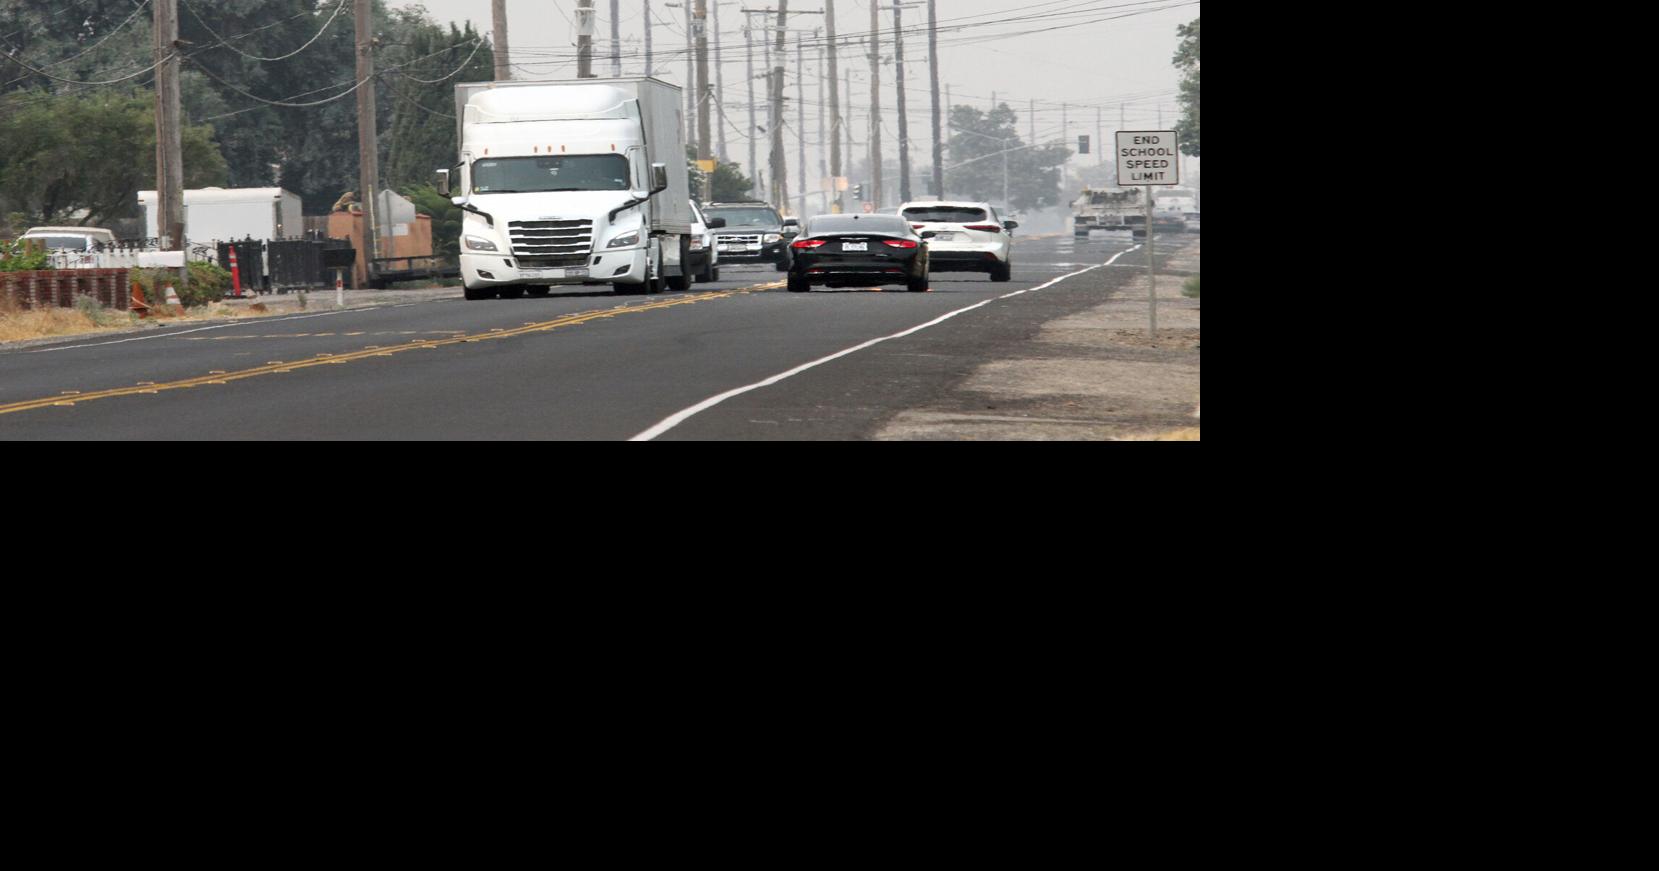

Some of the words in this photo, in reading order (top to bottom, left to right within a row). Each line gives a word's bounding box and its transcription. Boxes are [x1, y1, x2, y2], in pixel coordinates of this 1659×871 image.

[1133, 135, 1160, 145] END
[1121, 147, 1174, 157] SCHOOL
[1126, 159, 1169, 169] SPEED
[1131, 171, 1165, 181] LIMIT
